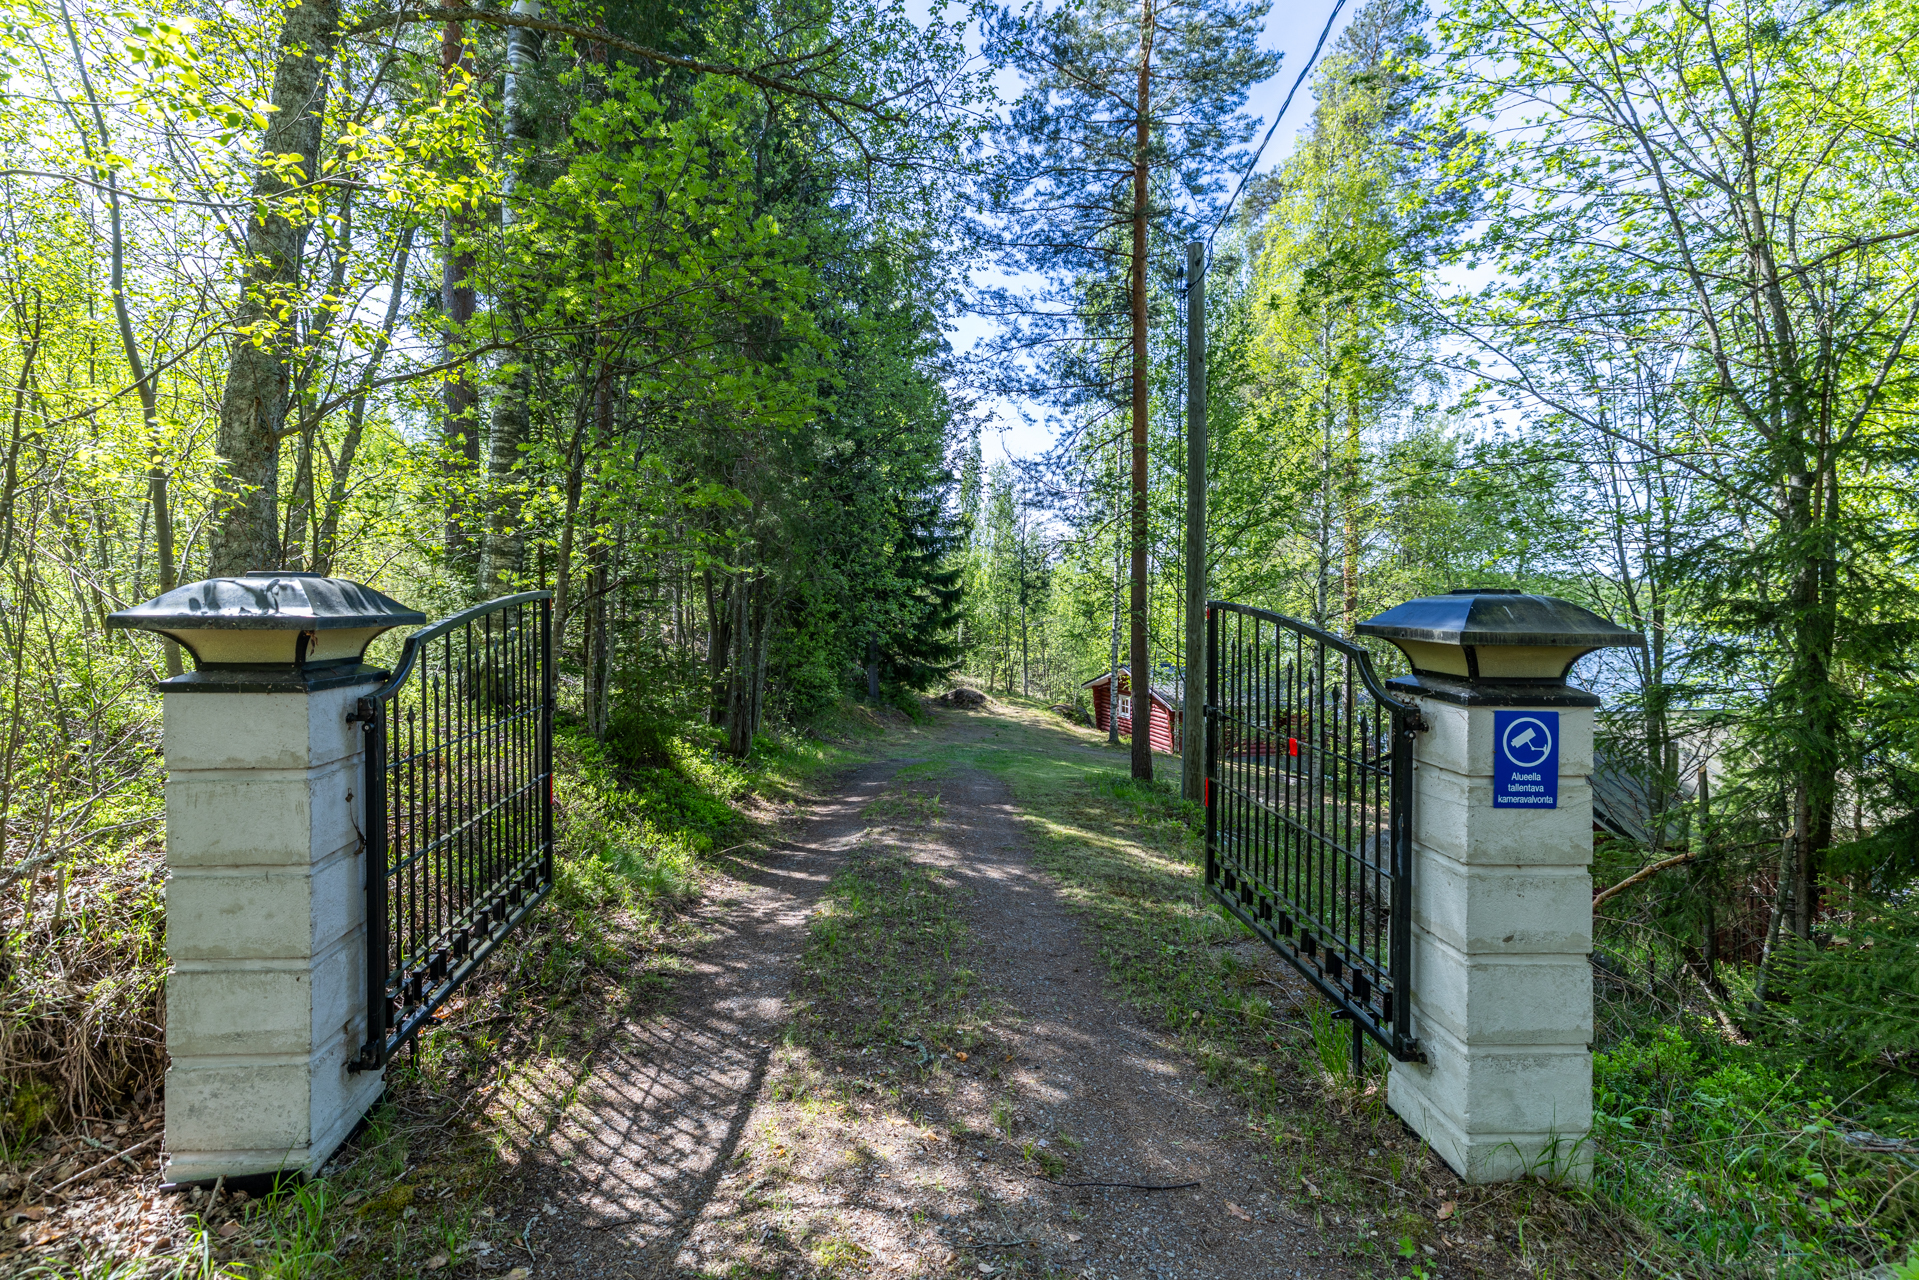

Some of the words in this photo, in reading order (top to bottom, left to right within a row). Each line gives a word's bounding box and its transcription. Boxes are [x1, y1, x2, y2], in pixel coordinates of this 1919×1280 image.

[1511, 772, 1541, 781] Alueella
[1508, 783, 1544, 792] tallentava
[1498, 795, 1553, 804] kameravalvonta
